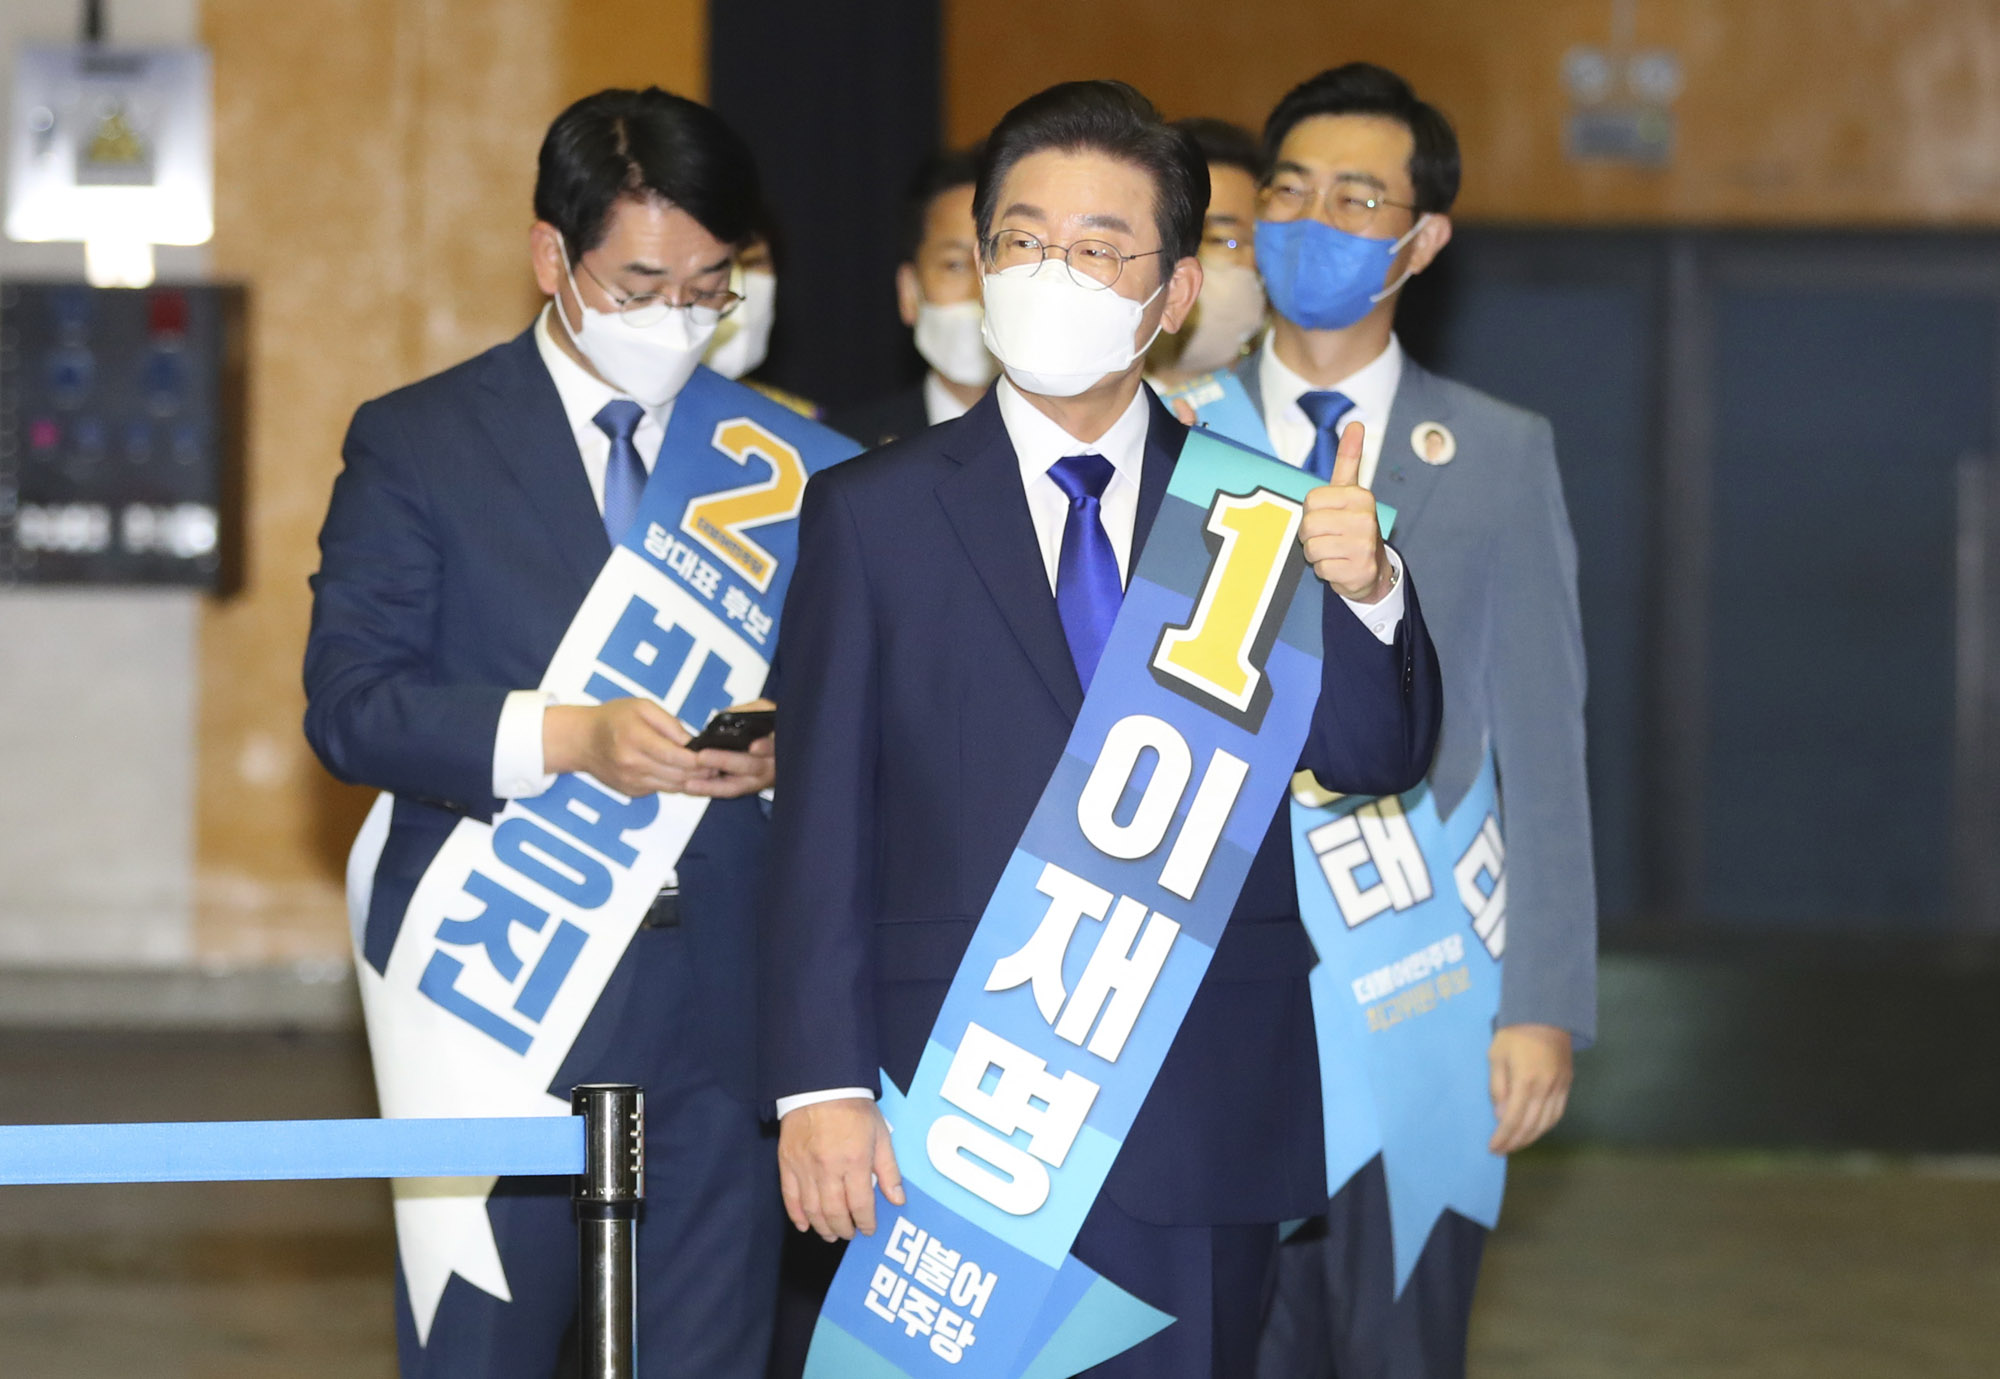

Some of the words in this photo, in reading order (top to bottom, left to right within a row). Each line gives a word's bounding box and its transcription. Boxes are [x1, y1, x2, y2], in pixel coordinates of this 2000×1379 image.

[643, 521, 722, 601] 당대표
[720, 584, 773, 646] 후보
[680, 416, 810, 595] 2
[1149, 486, 1307, 730] 1
[417, 594, 735, 1058] 박용진
[1291, 770, 1434, 932] 태
[926, 713, 1250, 1217] 이재명
[863, 1263, 977, 1365] 민주당
[884, 1215, 999, 1320] 더불어
